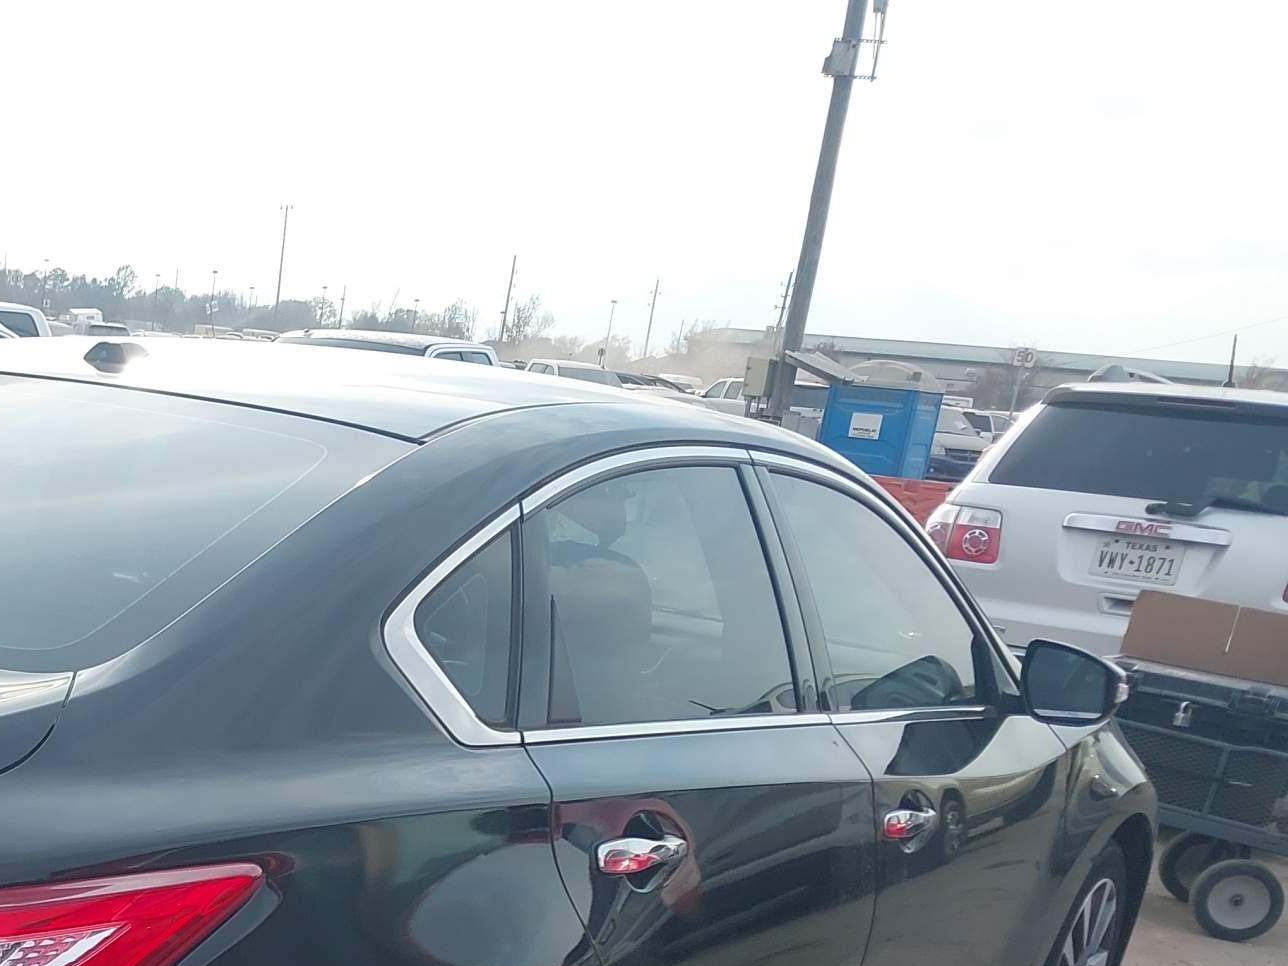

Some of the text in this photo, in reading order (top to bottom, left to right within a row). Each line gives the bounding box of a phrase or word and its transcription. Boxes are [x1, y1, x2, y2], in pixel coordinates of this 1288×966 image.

[1015, 350, 1034, 363] 50
[1115, 520, 1173, 537] GMC
[1126, 541, 1158, 552] TEXAS
